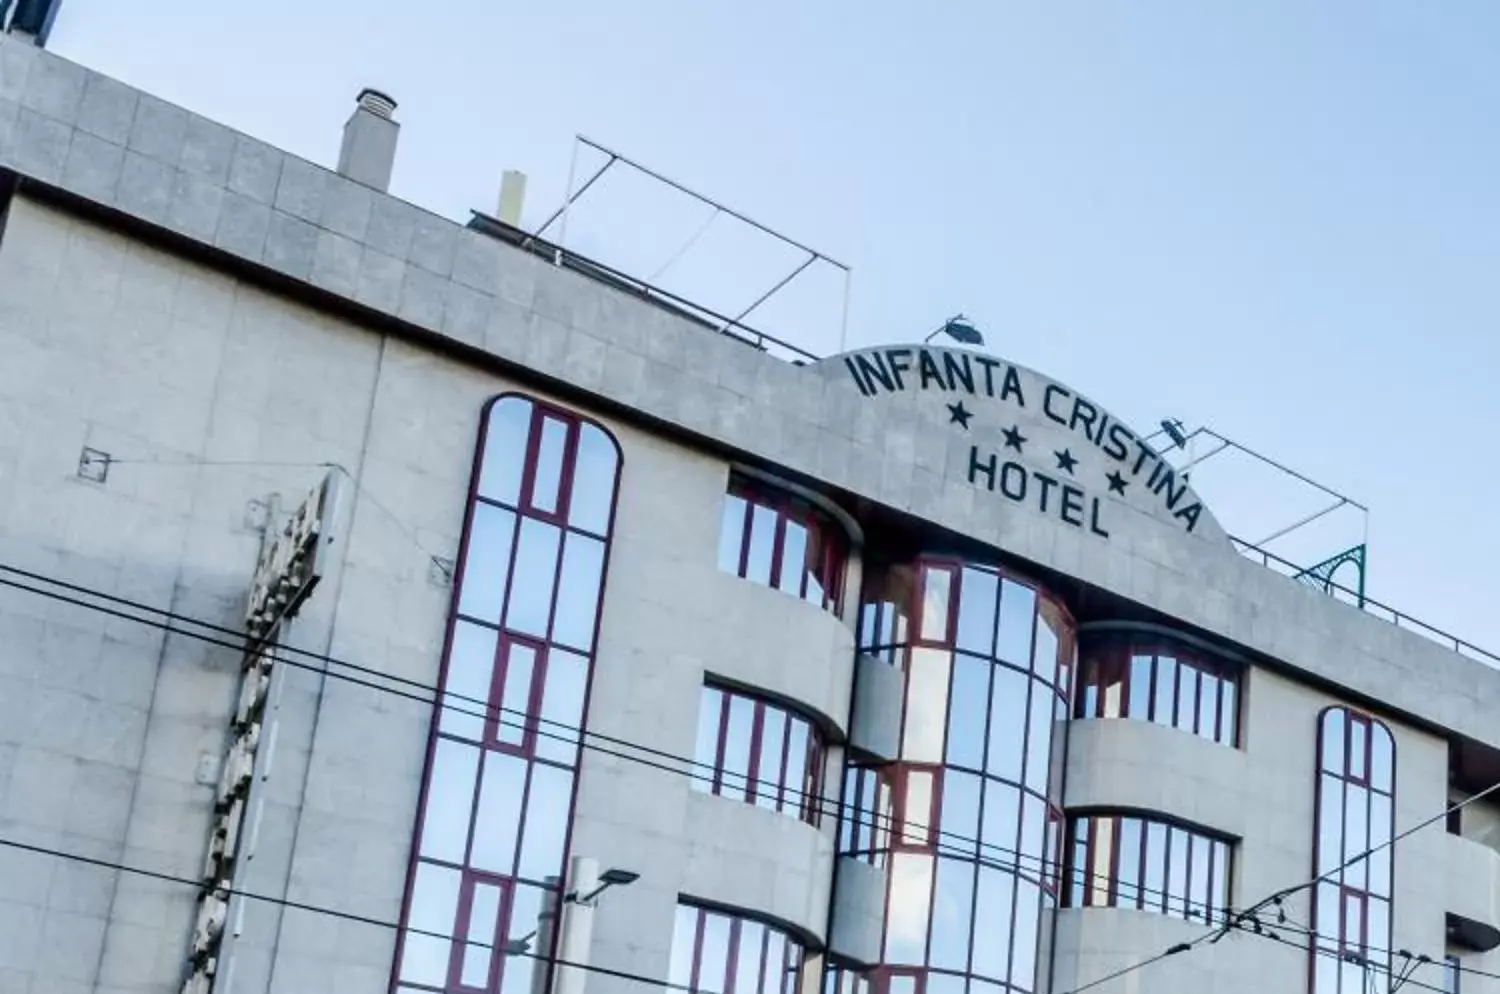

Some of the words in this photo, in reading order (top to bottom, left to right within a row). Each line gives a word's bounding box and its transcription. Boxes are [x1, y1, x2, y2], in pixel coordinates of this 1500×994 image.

[844, 348, 1025, 407] INFANTA
[1043, 383, 1204, 533] CRISTINA
[967, 445, 1110, 539] HOTEL
